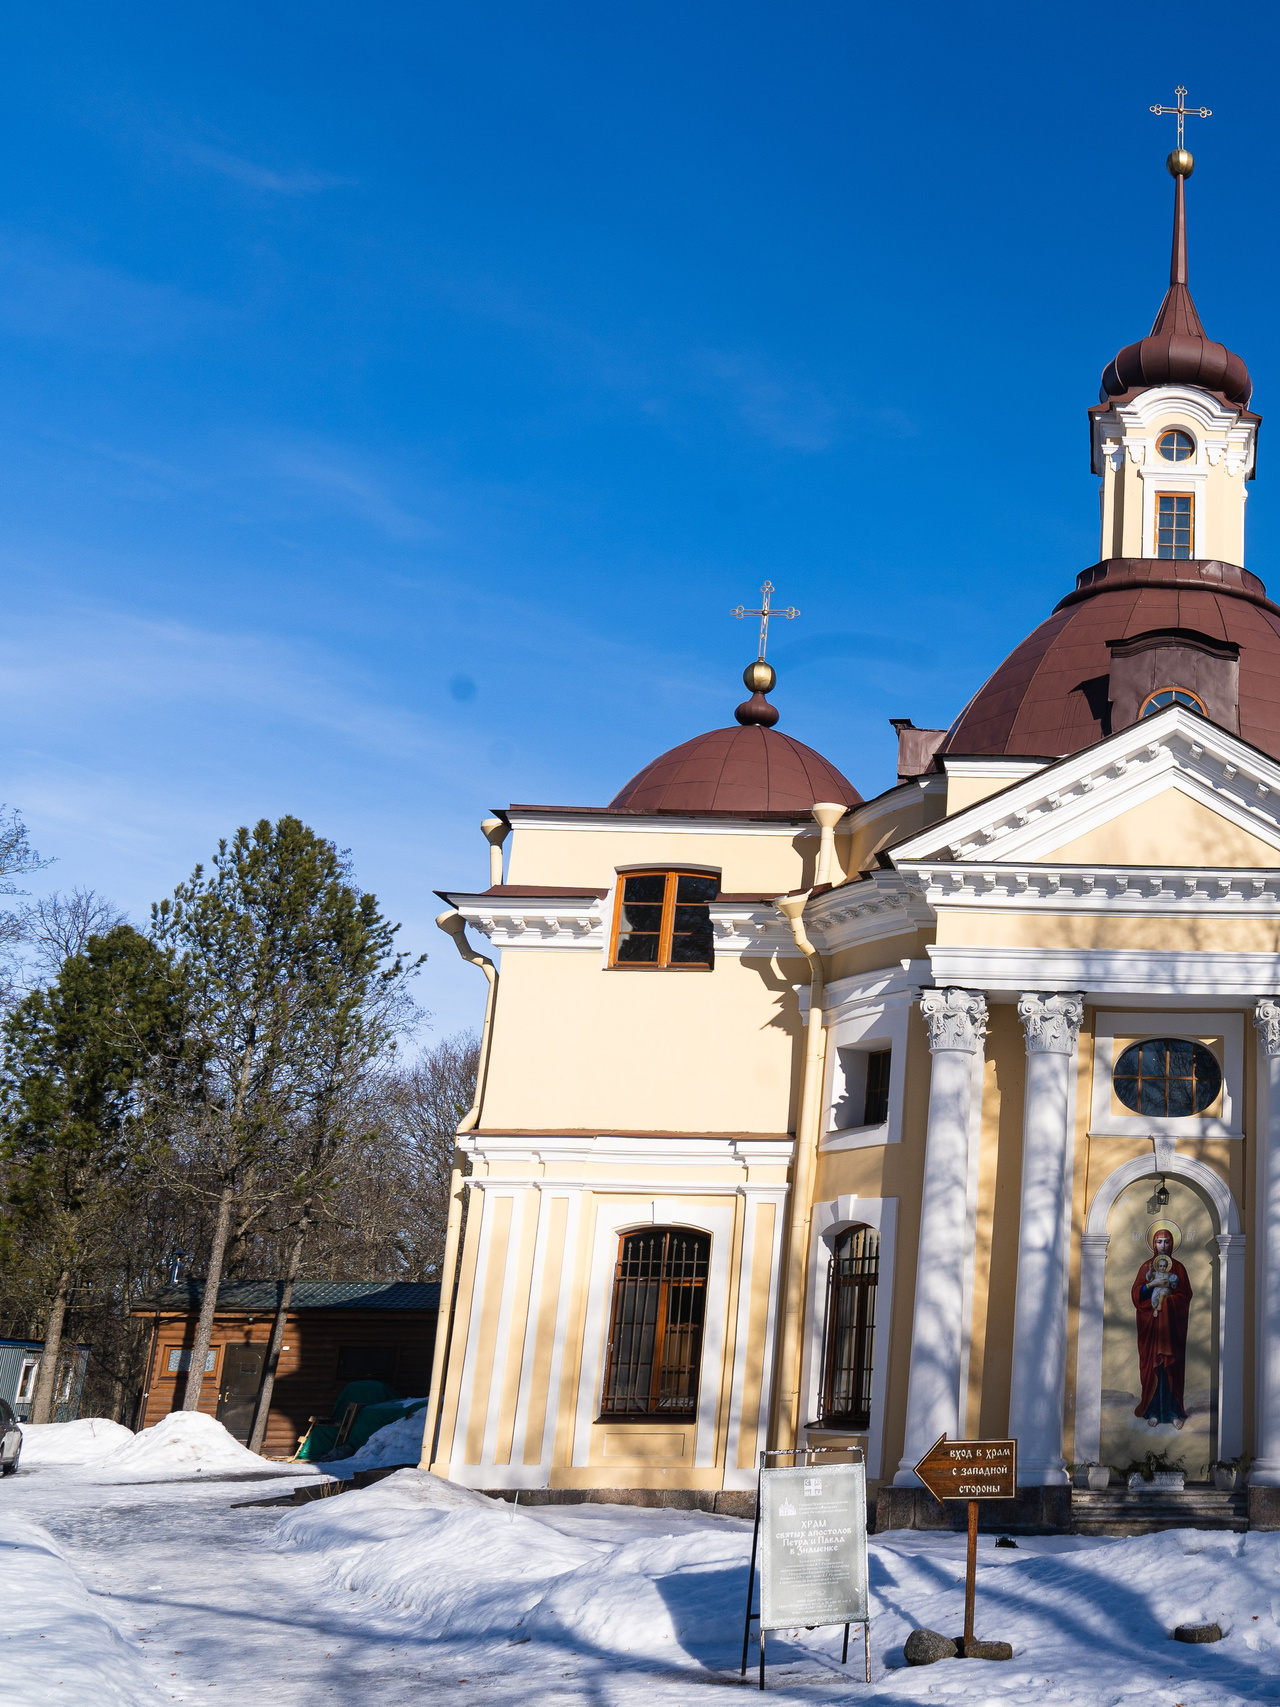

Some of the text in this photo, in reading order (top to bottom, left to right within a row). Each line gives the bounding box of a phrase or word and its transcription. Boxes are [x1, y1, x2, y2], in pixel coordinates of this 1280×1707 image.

[949, 1448, 1010, 1460] вход в храм
[952, 1465, 1008, 1476] с западной
[958, 1485, 1001, 1495] стороны
[801, 1519, 827, 1529] ХРАМ
[775, 1527, 852, 1539] святых апостолов
[782, 1538, 809, 1547] Петра
[817, 1536, 845, 1544] Павла
[796, 1545, 839, 1556] Знаменке
